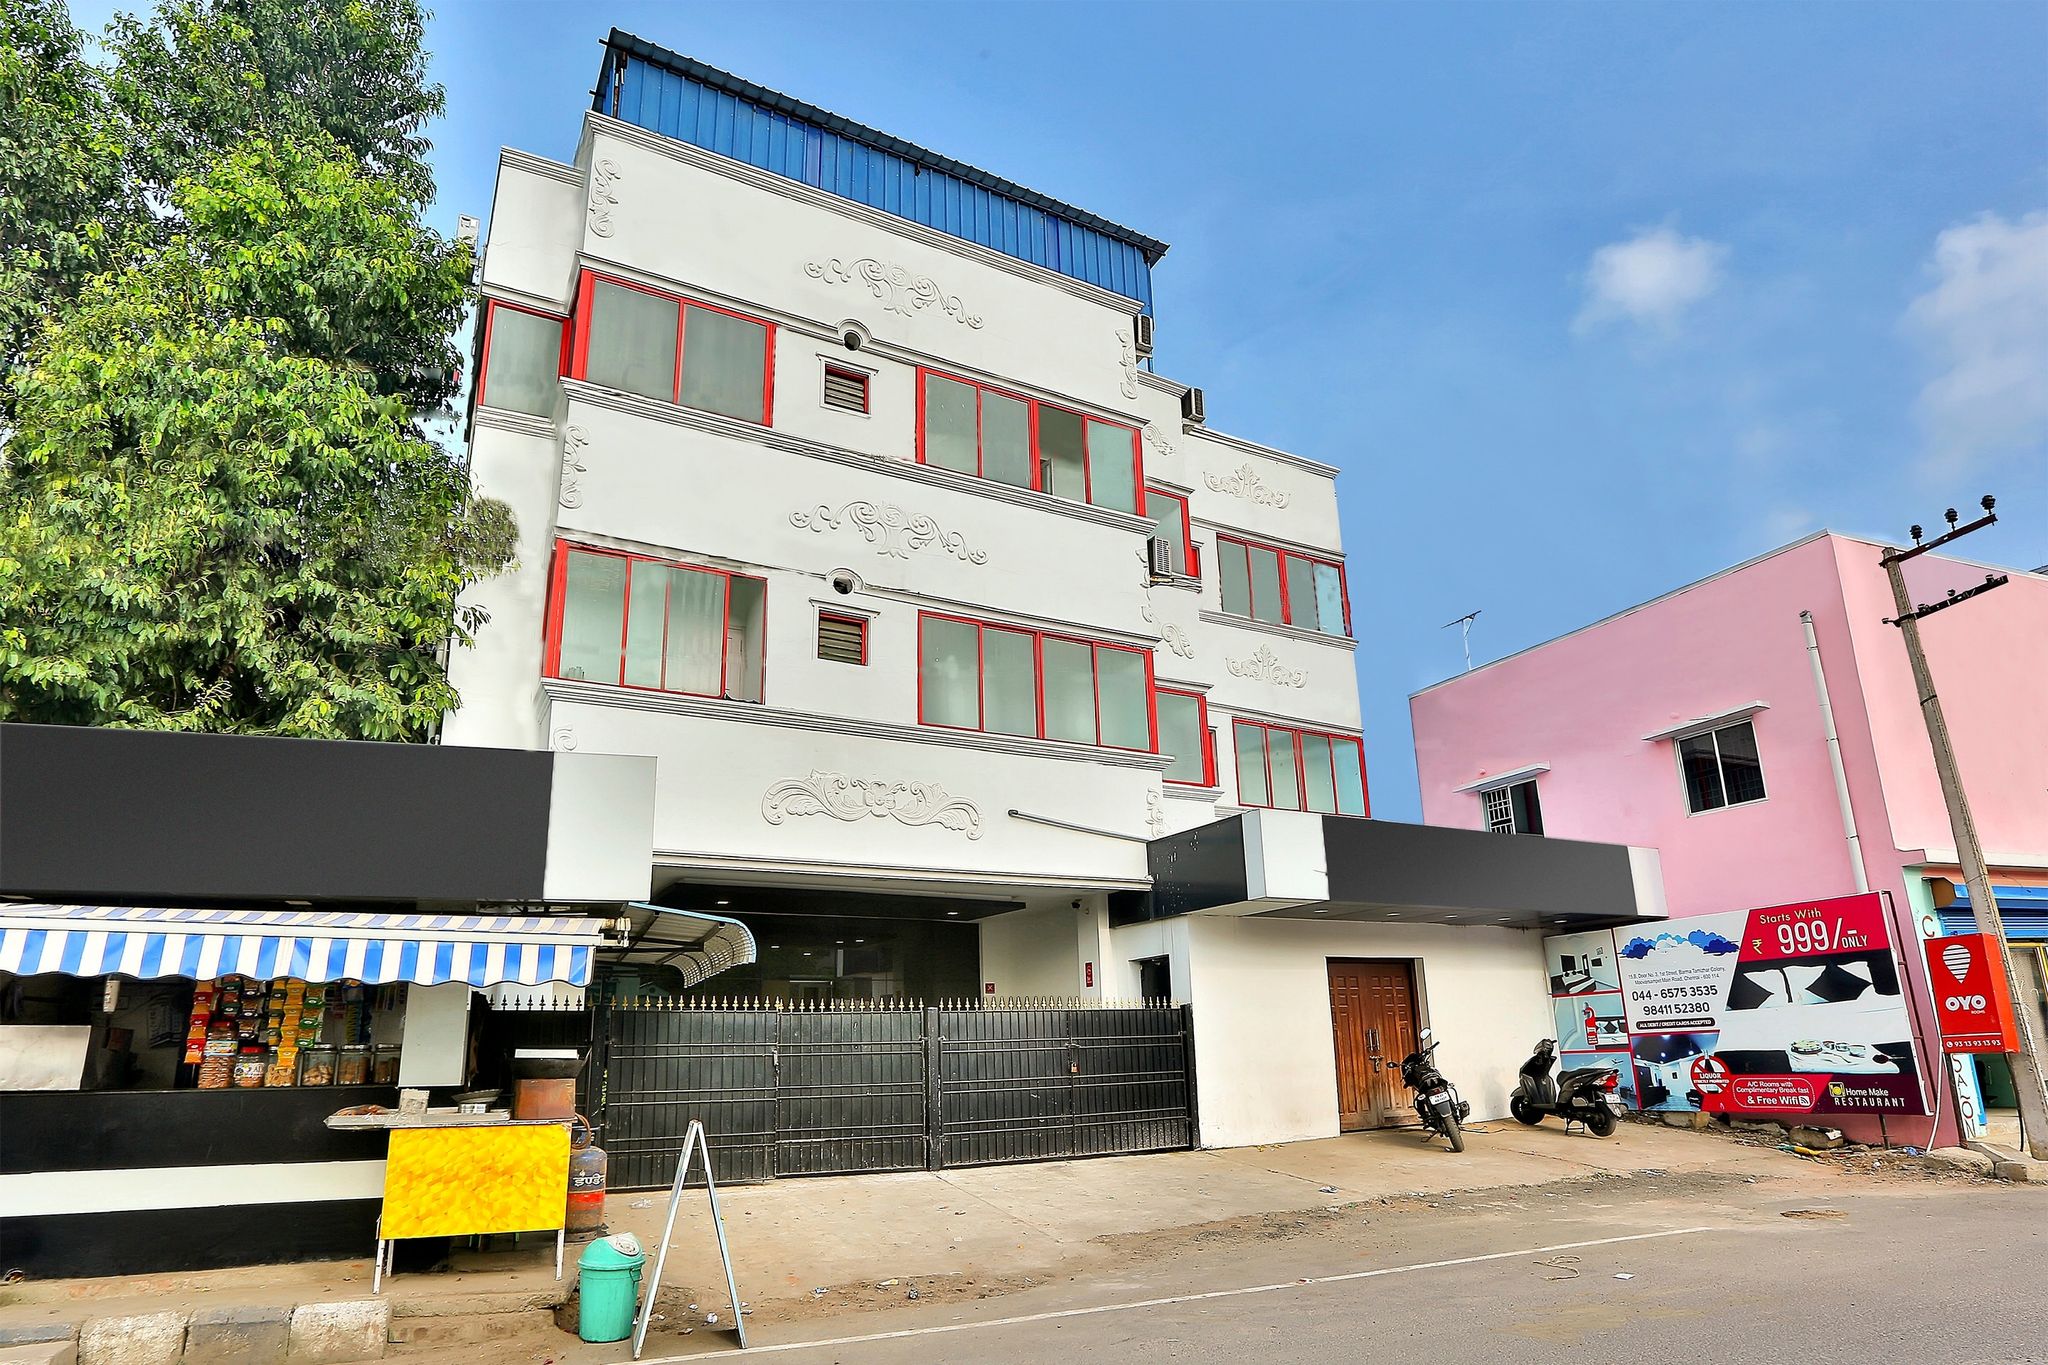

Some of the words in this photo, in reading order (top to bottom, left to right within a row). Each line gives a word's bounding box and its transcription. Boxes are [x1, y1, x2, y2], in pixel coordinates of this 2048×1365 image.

[1760, 913, 1791, 924] Starts
[1794, 907, 1822, 920] With
[1841, 934, 1868, 949] ONLY
[1632, 990, 1652, 1001] 044
[1660, 987, 1688, 999] 6575
[1689, 985, 1718, 996] 3535
[1945, 994, 1986, 1011] OYO
[1736, 1086, 1778, 1094] Complimentary
[1845, 1087, 1868, 1096] Home
[1868, 1087, 1889, 1096] Make
[1747, 1095, 1755, 1104] &
[1756, 1095, 1778, 1104] Free
[1779, 1095, 1799, 1104] Wifi
[1834, 1096, 1905, 1107] RESTAURANT
